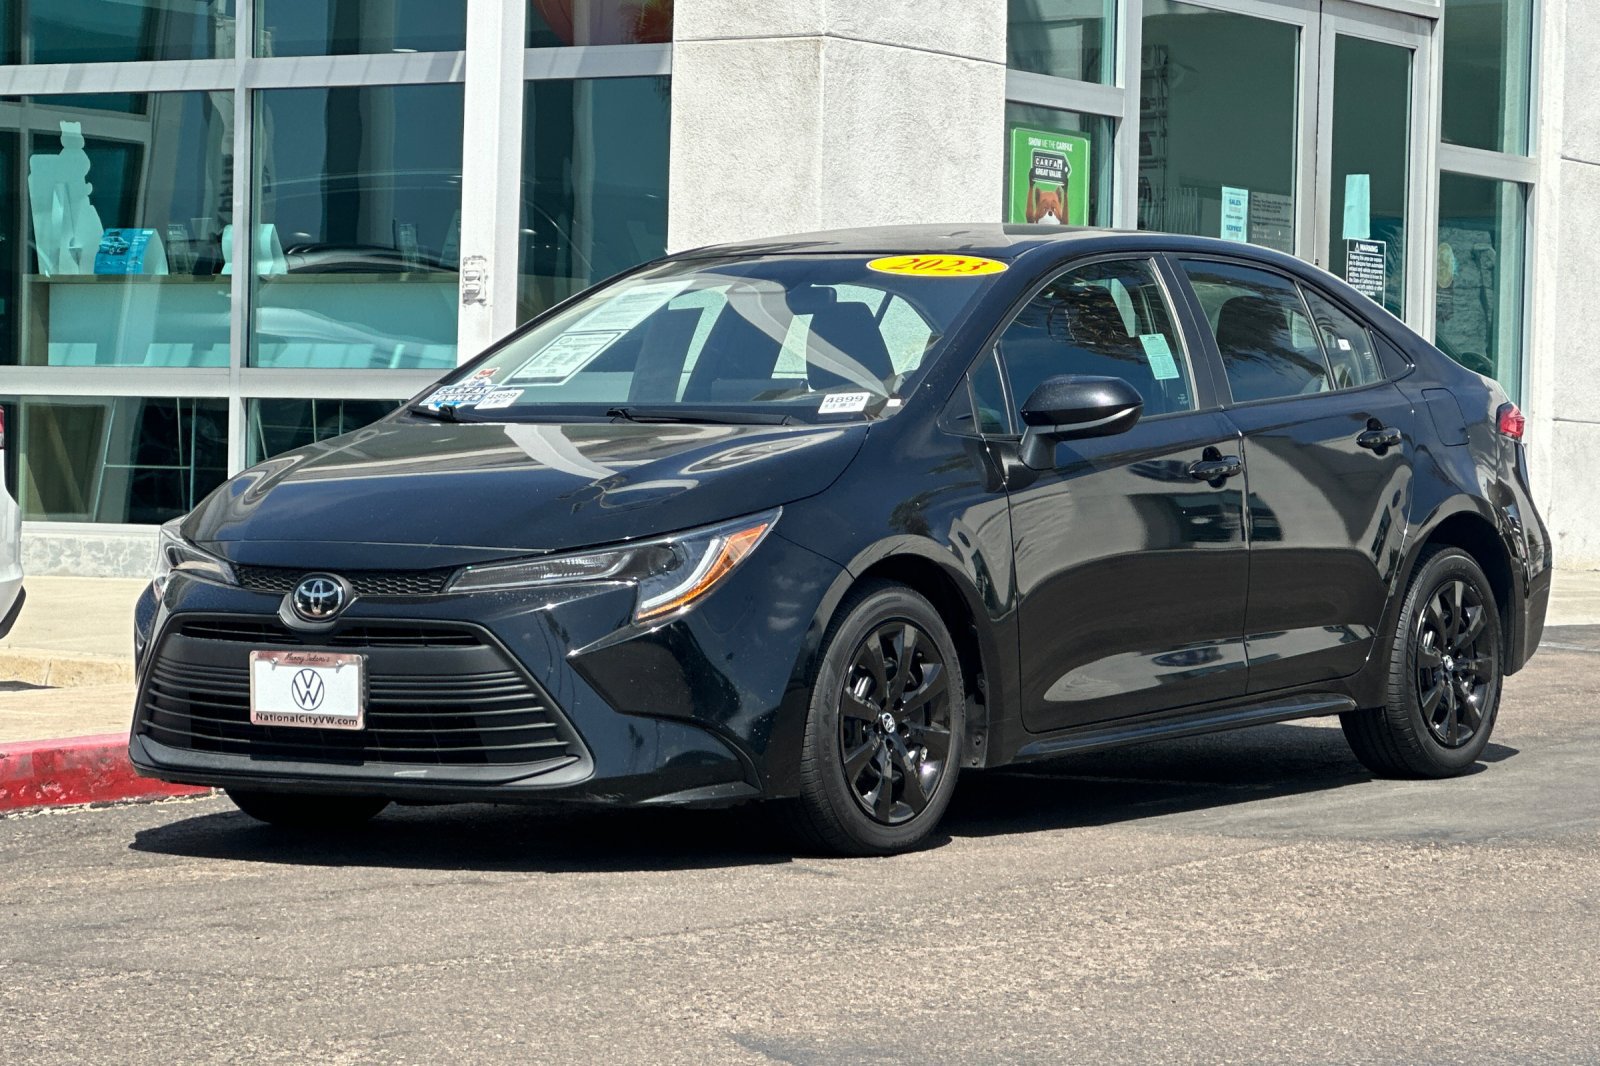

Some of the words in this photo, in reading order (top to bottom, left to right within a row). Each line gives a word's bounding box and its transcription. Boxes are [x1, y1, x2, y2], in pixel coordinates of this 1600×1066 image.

[1028, 137, 1041, 146] SHOW
[1056, 141, 1073, 151] CARFAX
[1035, 157, 1062, 170] CARFAX
[1035, 168, 1049, 176] GREAT
[1049, 170, 1061, 178] VALUE
[1360, 244, 1378, 253] WARNING
[888, 257, 989, 273] 2023
[825, 395, 864, 403] 4899
[255, 712, 358, 726] NationalCityVW.com
